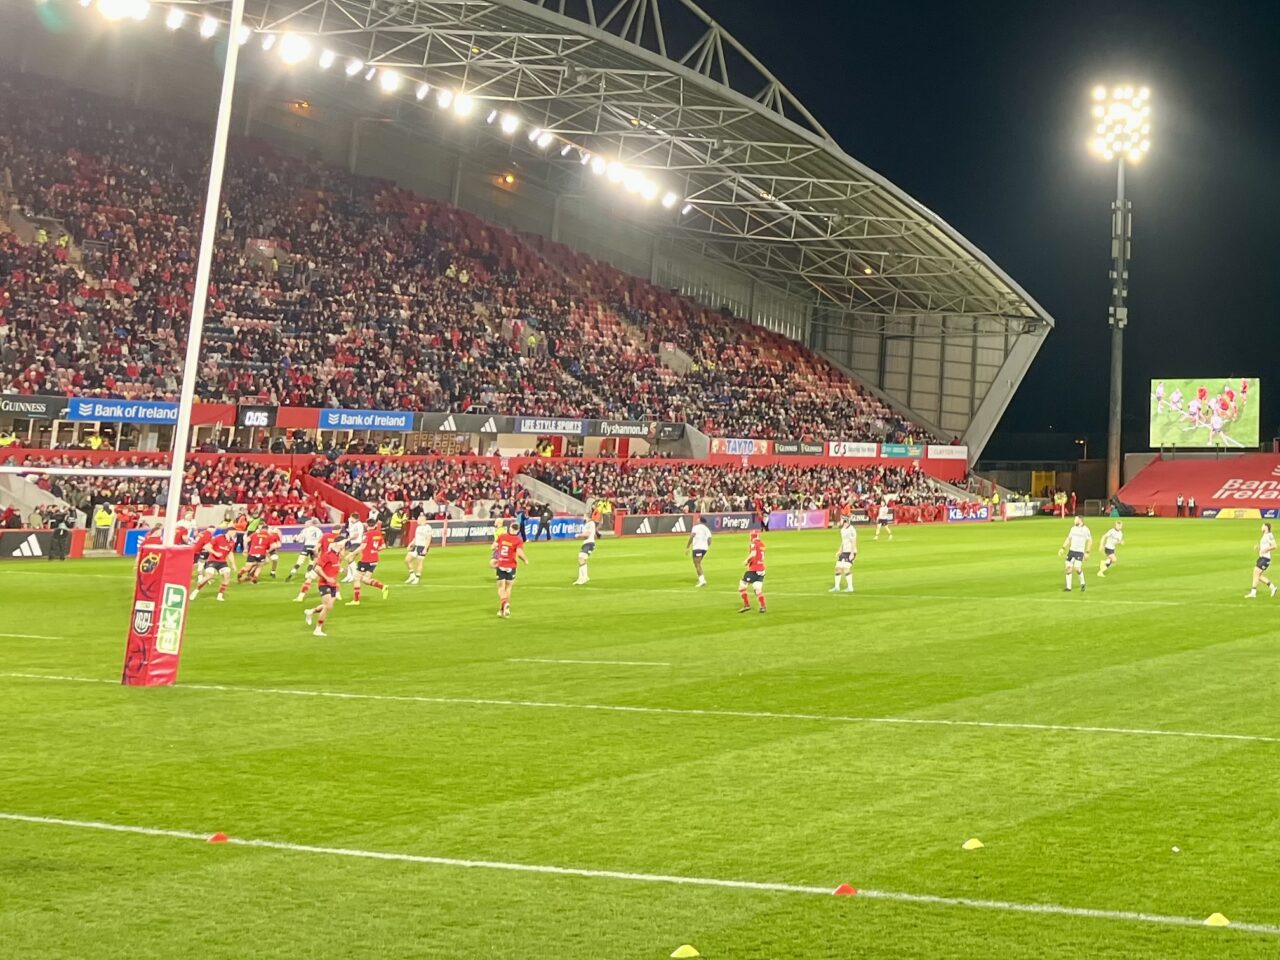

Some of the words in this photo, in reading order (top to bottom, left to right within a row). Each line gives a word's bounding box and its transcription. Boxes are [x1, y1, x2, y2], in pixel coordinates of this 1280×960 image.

[1, 400, 46, 413] GUINNESS
[95, 404, 122, 417] Bank
[124, 405, 137, 418] of
[138, 406, 178, 419] Ireland
[340, 414, 363, 426] Bank
[364, 414, 374, 426] of
[374, 415, 405, 427] Ireland
[521, 420, 535, 431] LIFE
[536, 420, 556, 431] STYLE
[557, 421, 582, 433] SPORTS
[600, 422, 648, 436] flyshannon.ie
[726, 440, 754, 453] TAYTO
[834, 444, 847, 455] GS
[552, 524, 561, 533] of
[562, 523, 585, 533] Irelan
[722, 517, 750, 528] Pinergy
[501, 546, 509, 555] 2
